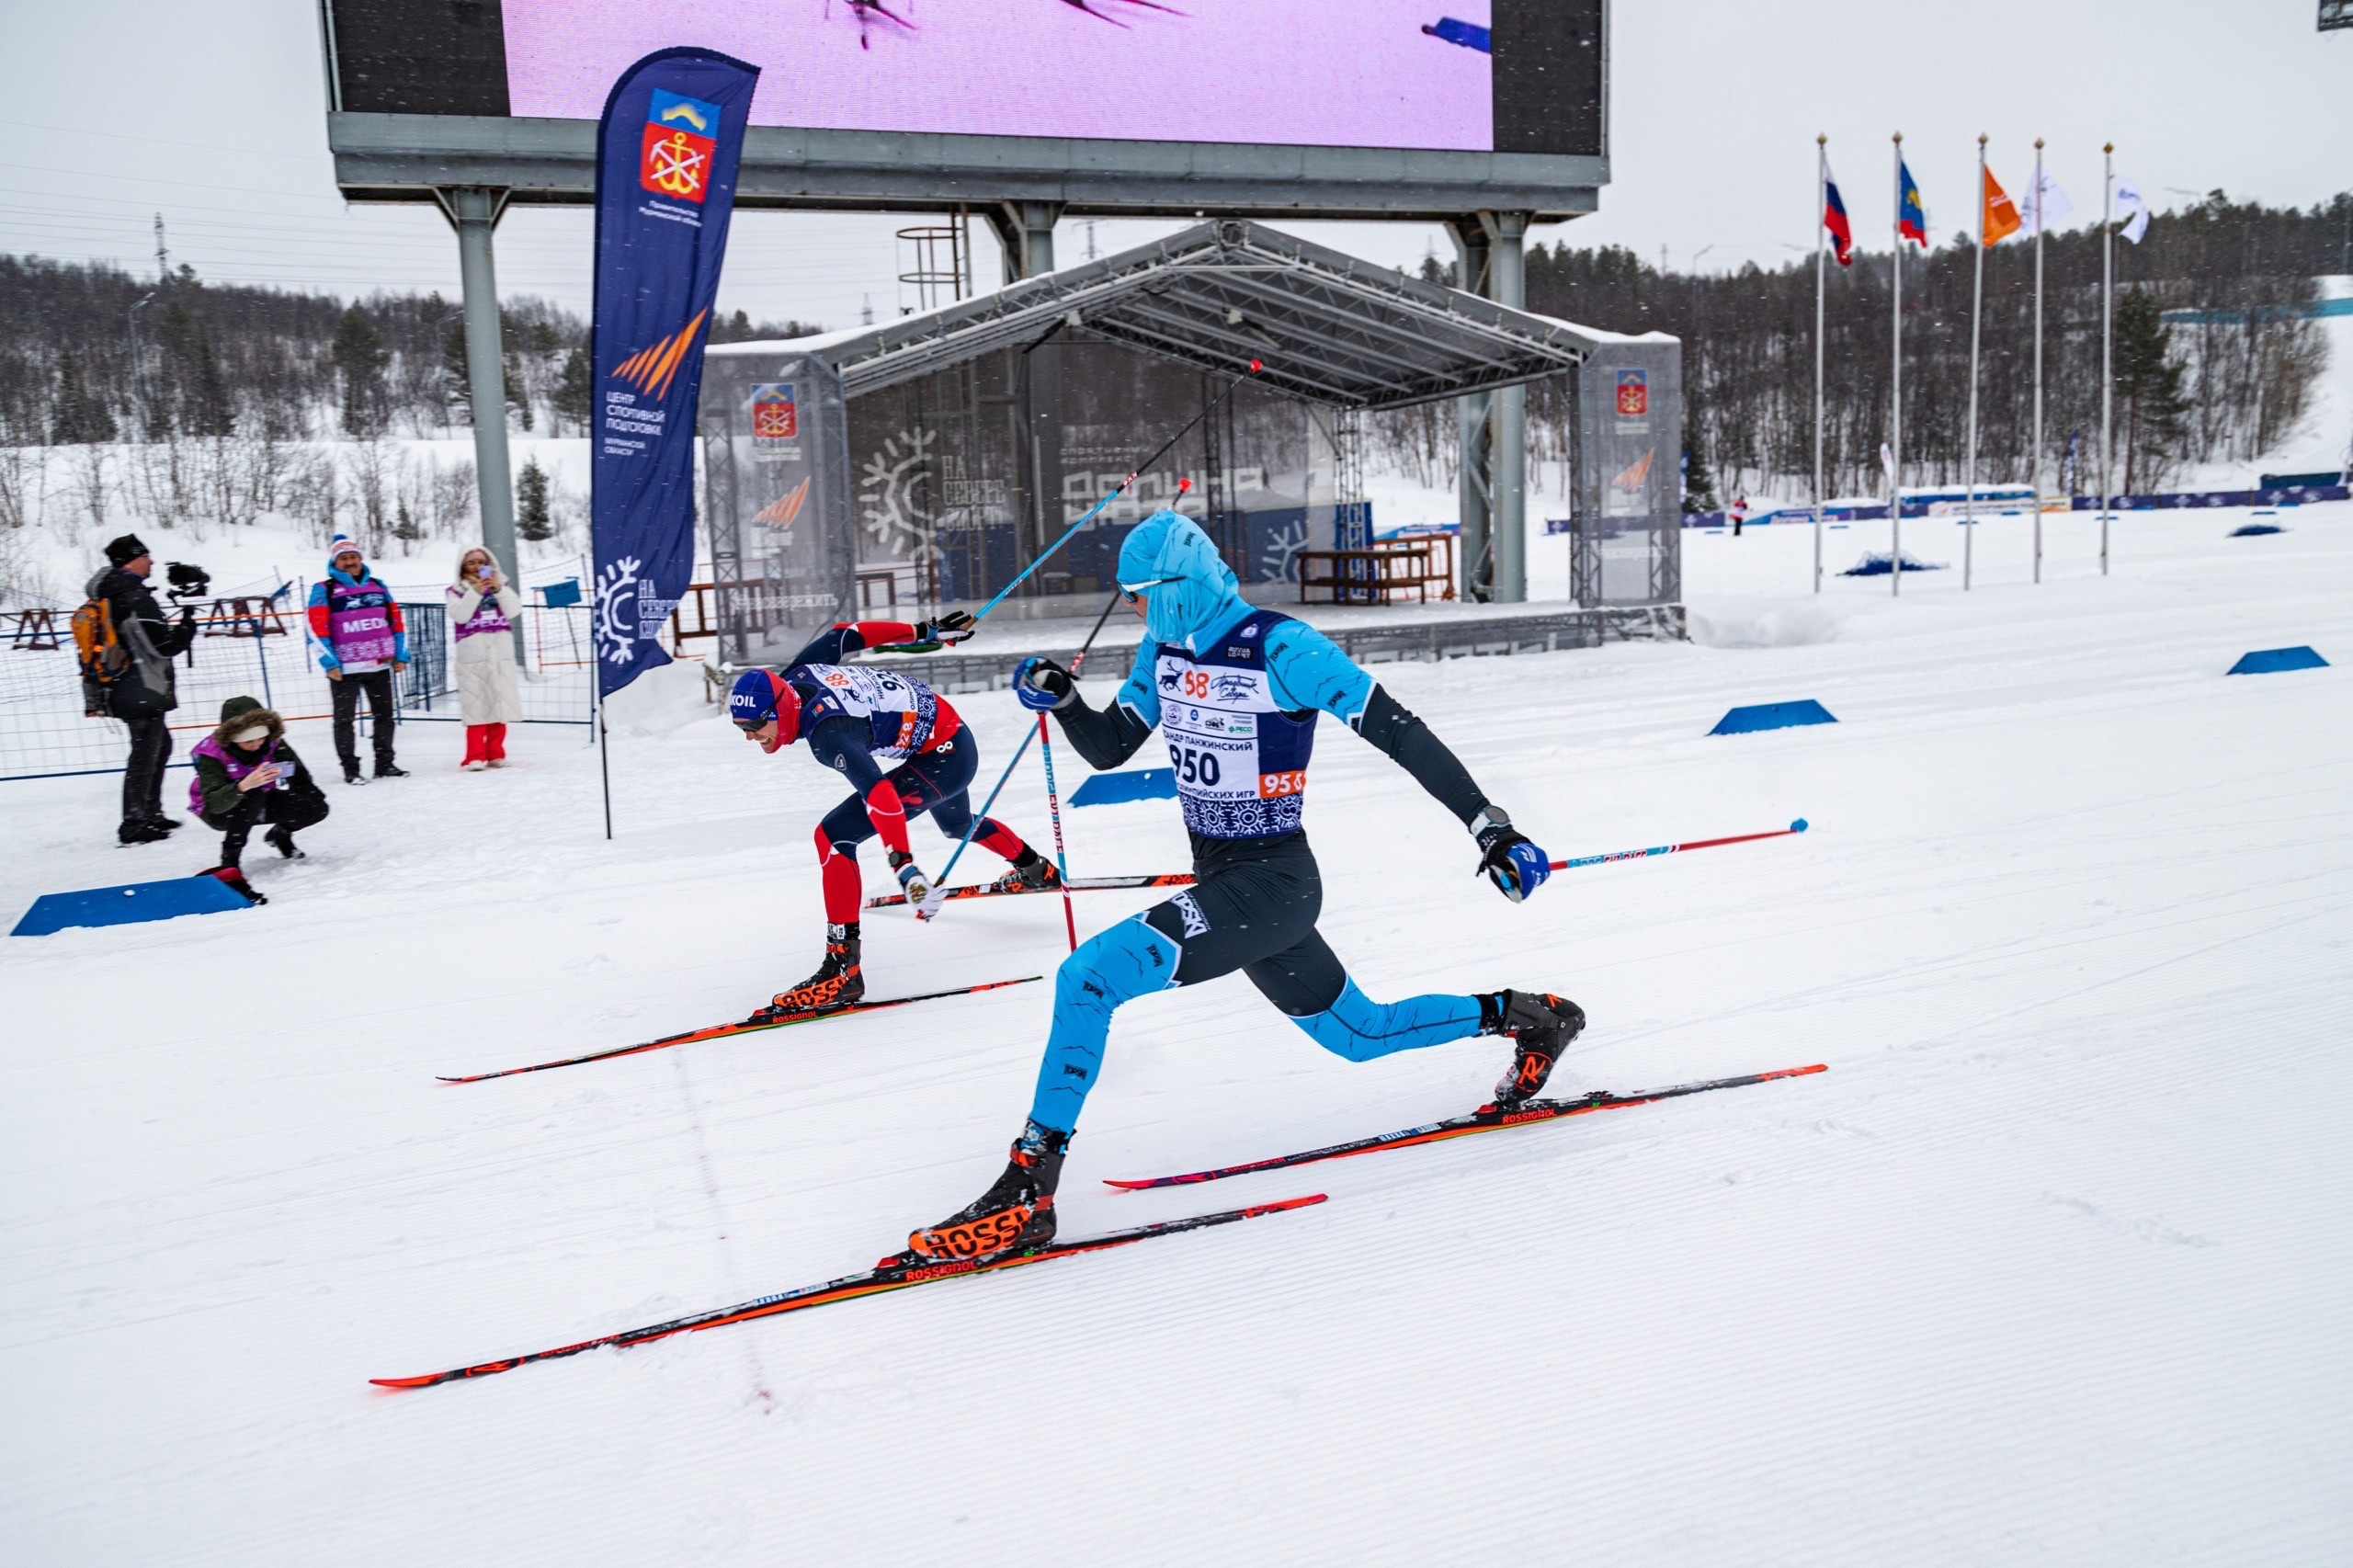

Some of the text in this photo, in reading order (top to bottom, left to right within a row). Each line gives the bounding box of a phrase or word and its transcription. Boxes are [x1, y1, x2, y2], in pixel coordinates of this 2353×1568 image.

[607, 392, 636, 404] ЦЕНТР
[606, 404, 665, 422] СПОРТИВНОЙ
[941, 455, 967, 480] НА
[1061, 456, 1131, 464] КОМПЛЕКС
[1186, 735, 1253, 752] ПАНЖИНСКИЙ
[1169, 744, 1221, 787] 950
[1236, 790, 1256, 800] ИГР
[781, 977, 847, 1009] ROSSI
[772, 1011, 818, 1024] ROSSIGNOL
[1502, 1108, 1557, 1125] ROSSIGNOL
[924, 1210, 1027, 1258] ROSSI
[904, 1262, 978, 1282] ROSSIGNOL
